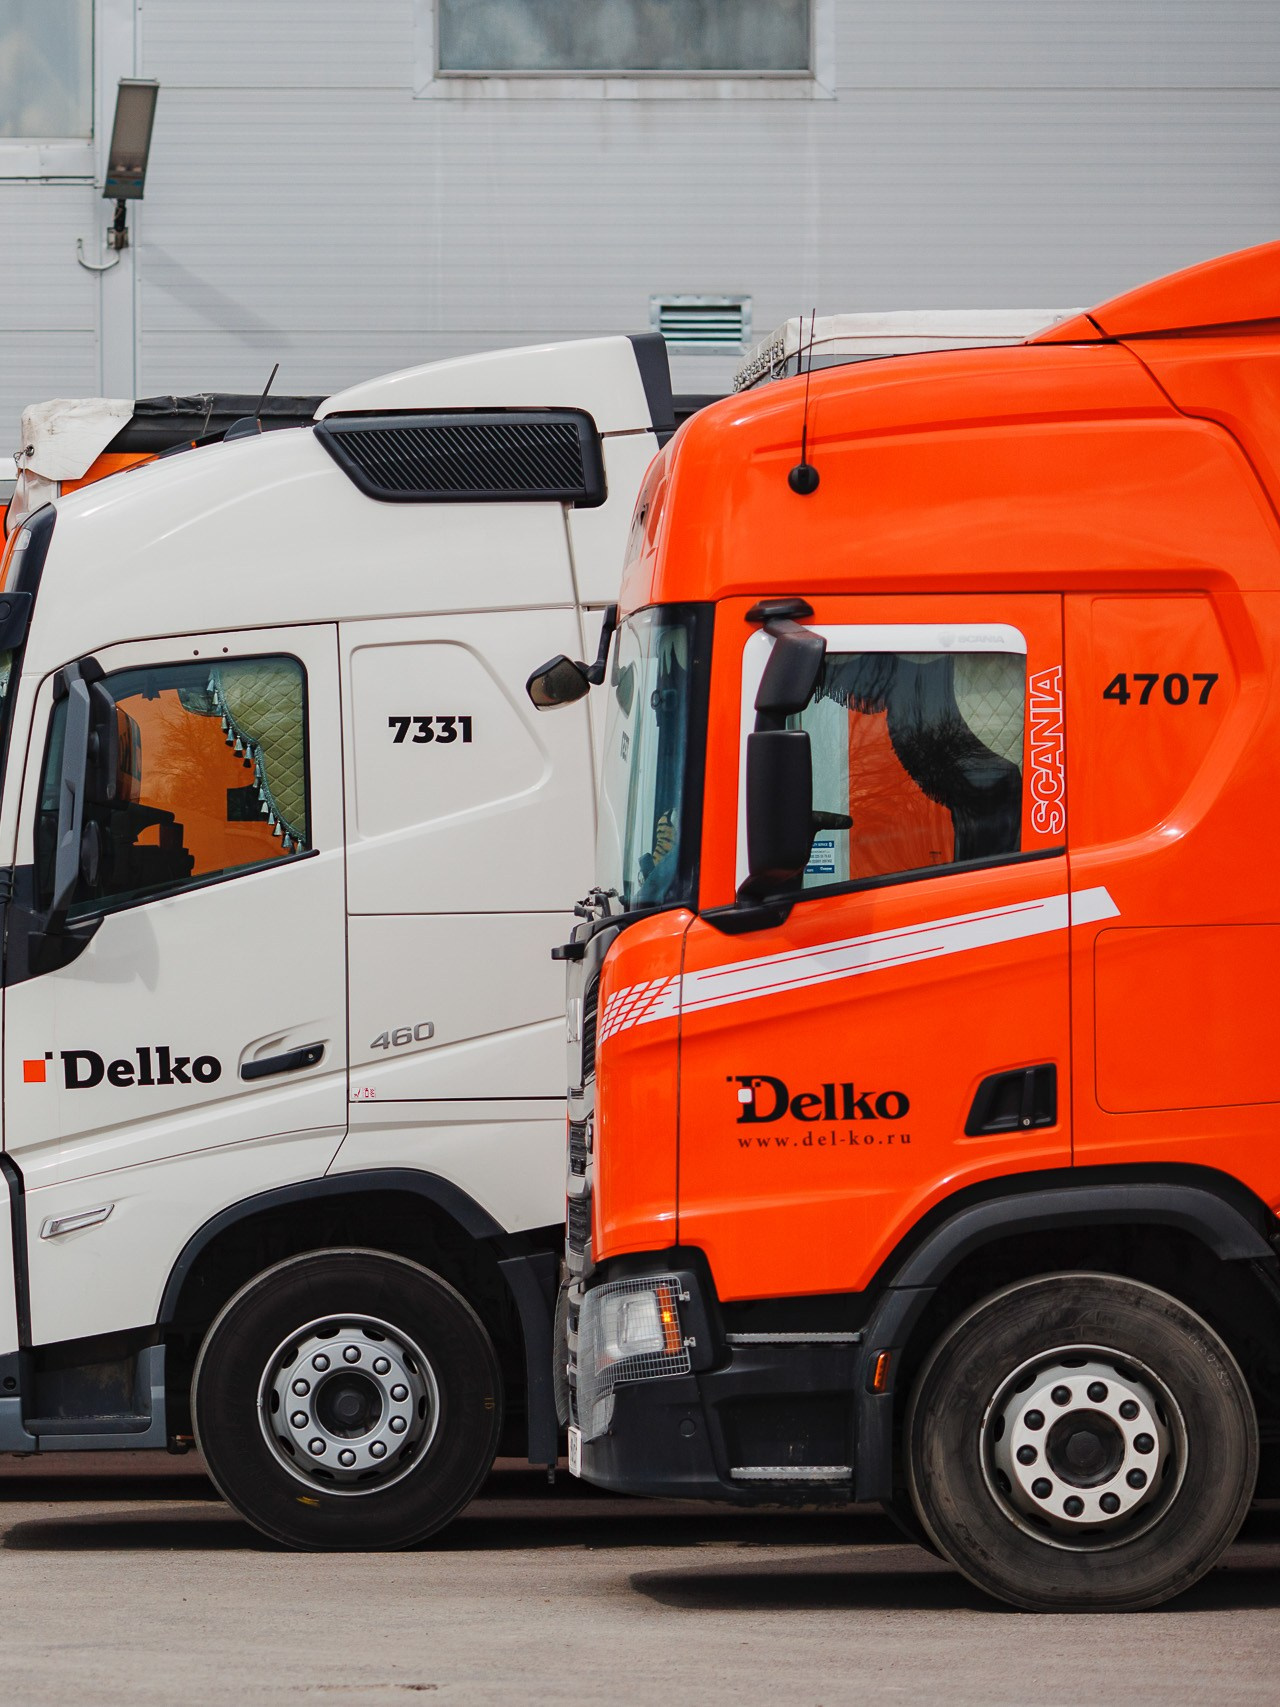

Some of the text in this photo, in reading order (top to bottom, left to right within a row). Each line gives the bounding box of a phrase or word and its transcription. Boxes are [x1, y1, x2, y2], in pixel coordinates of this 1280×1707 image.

[1103, 673, 1219, 705] 4707
[388, 716, 472, 743] 7331
[1029, 665, 1065, 834] SCANIA
[370, 1021, 435, 1049] 460
[60, 1046, 222, 1089] Delko
[728, 1076, 910, 1124] Delko
[738, 1130, 911, 1147] www.del-ko.ru
